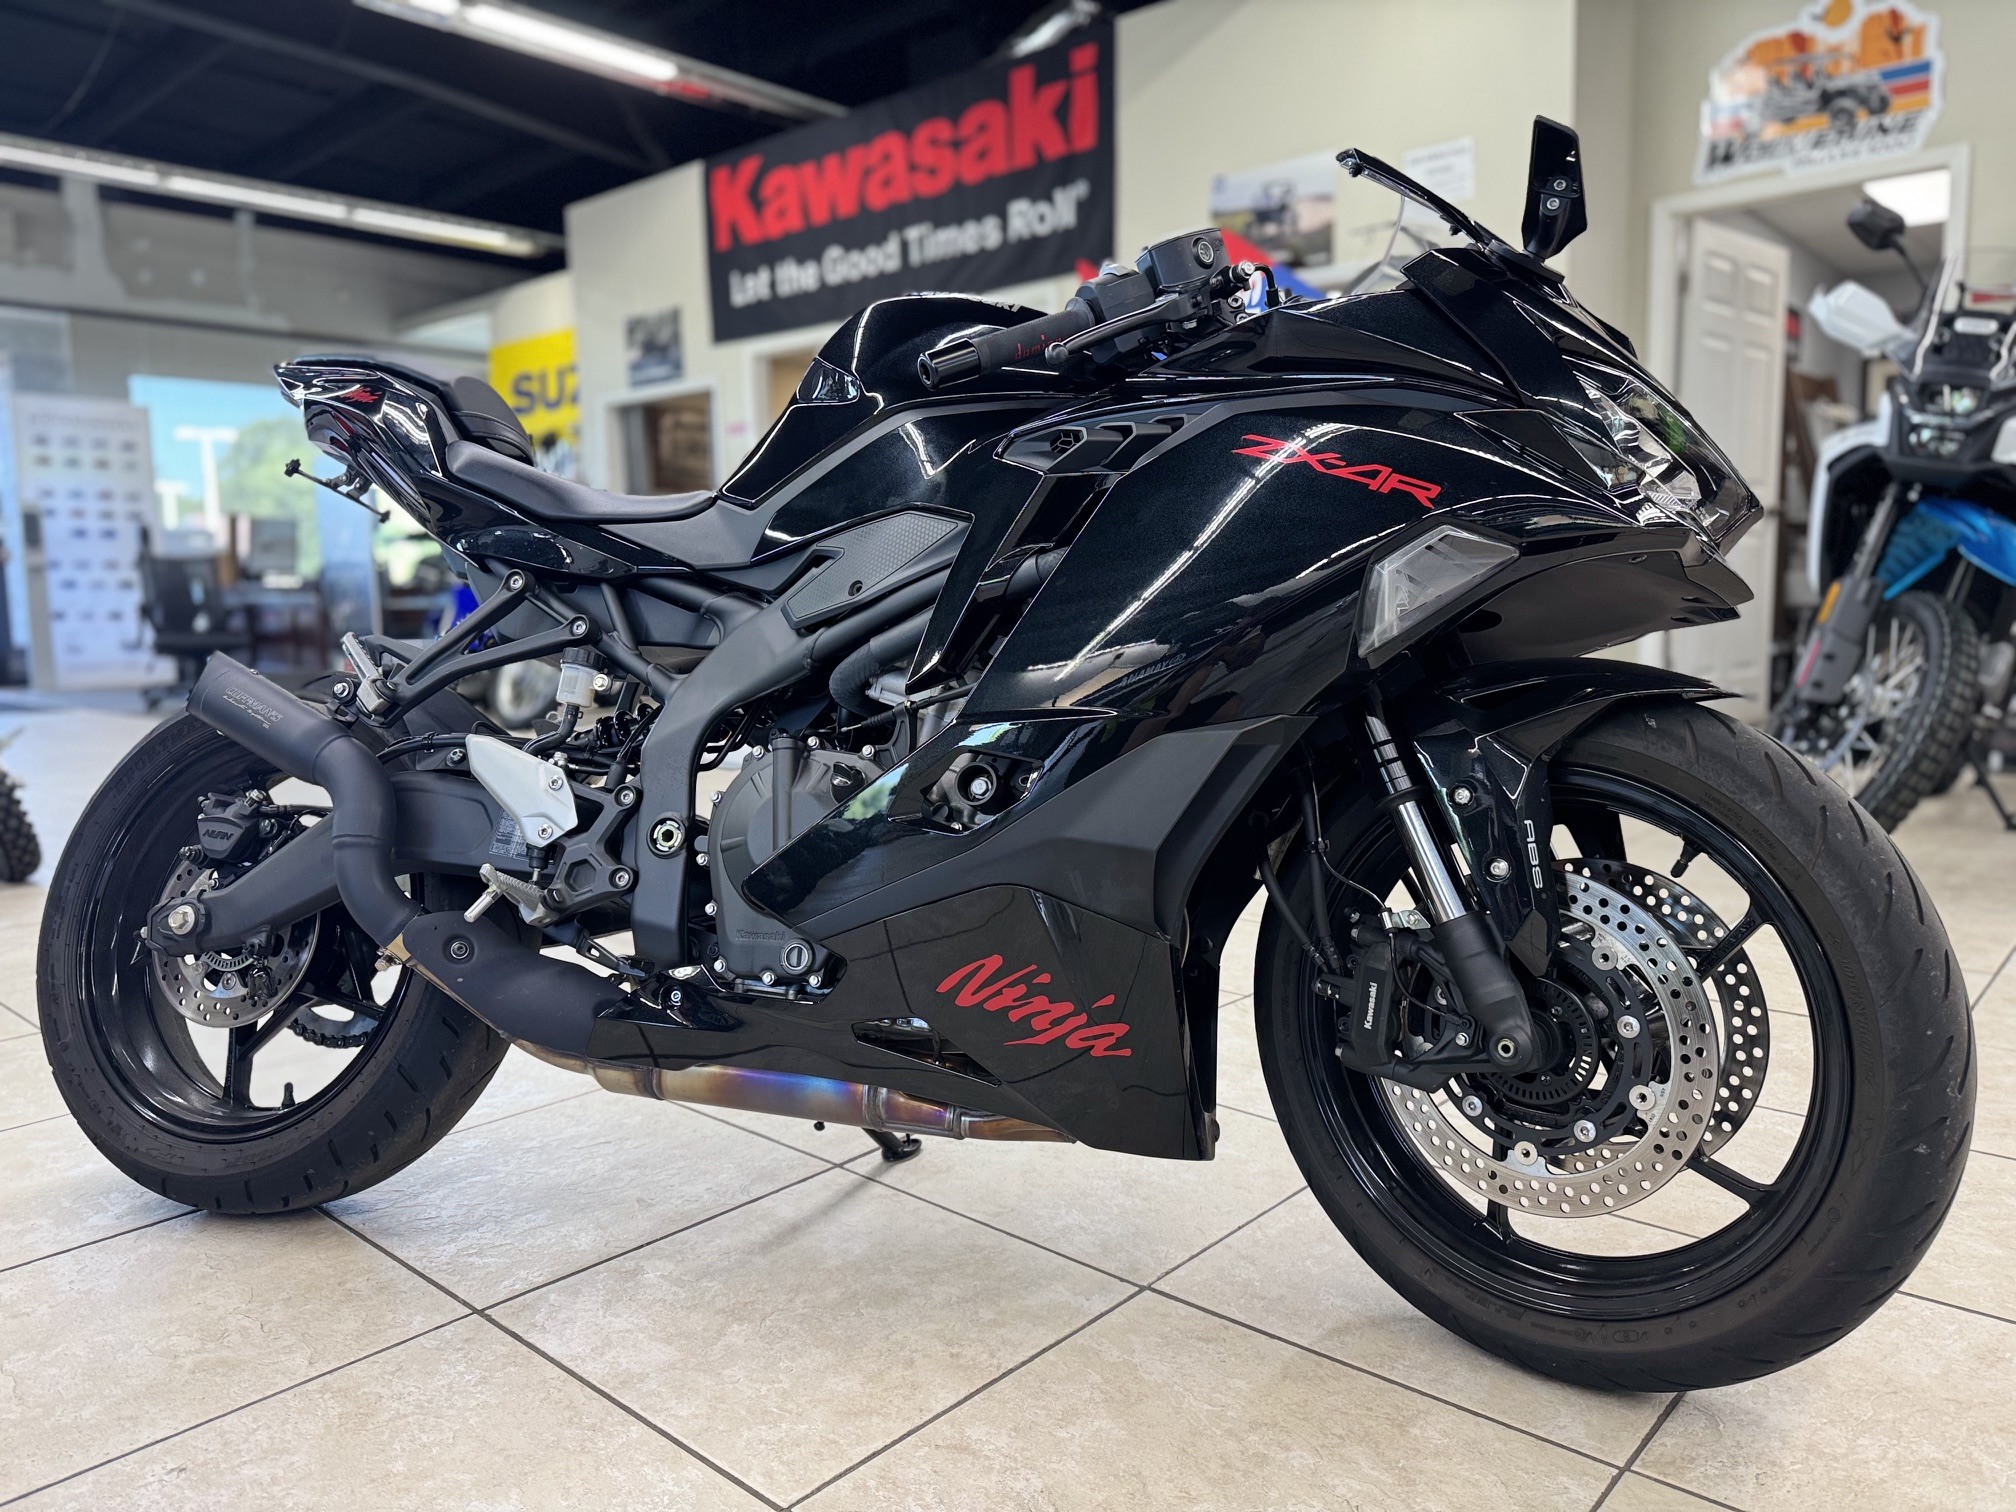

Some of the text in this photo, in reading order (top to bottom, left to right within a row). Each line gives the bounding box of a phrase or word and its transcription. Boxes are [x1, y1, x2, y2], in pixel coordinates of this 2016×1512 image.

[708, 42, 1099, 252] Kawasaki
[728, 262, 769, 309] Let
[774, 255, 820, 295] the
[821, 231, 903, 287] Good
[904, 213, 1004, 268] Times
[1523, 819, 1544, 889] ABS
[735, 929, 786, 941] Kawasaki
[935, 954, 1132, 1057] Ninja
[1363, 982, 1378, 1030] Kawasaki
